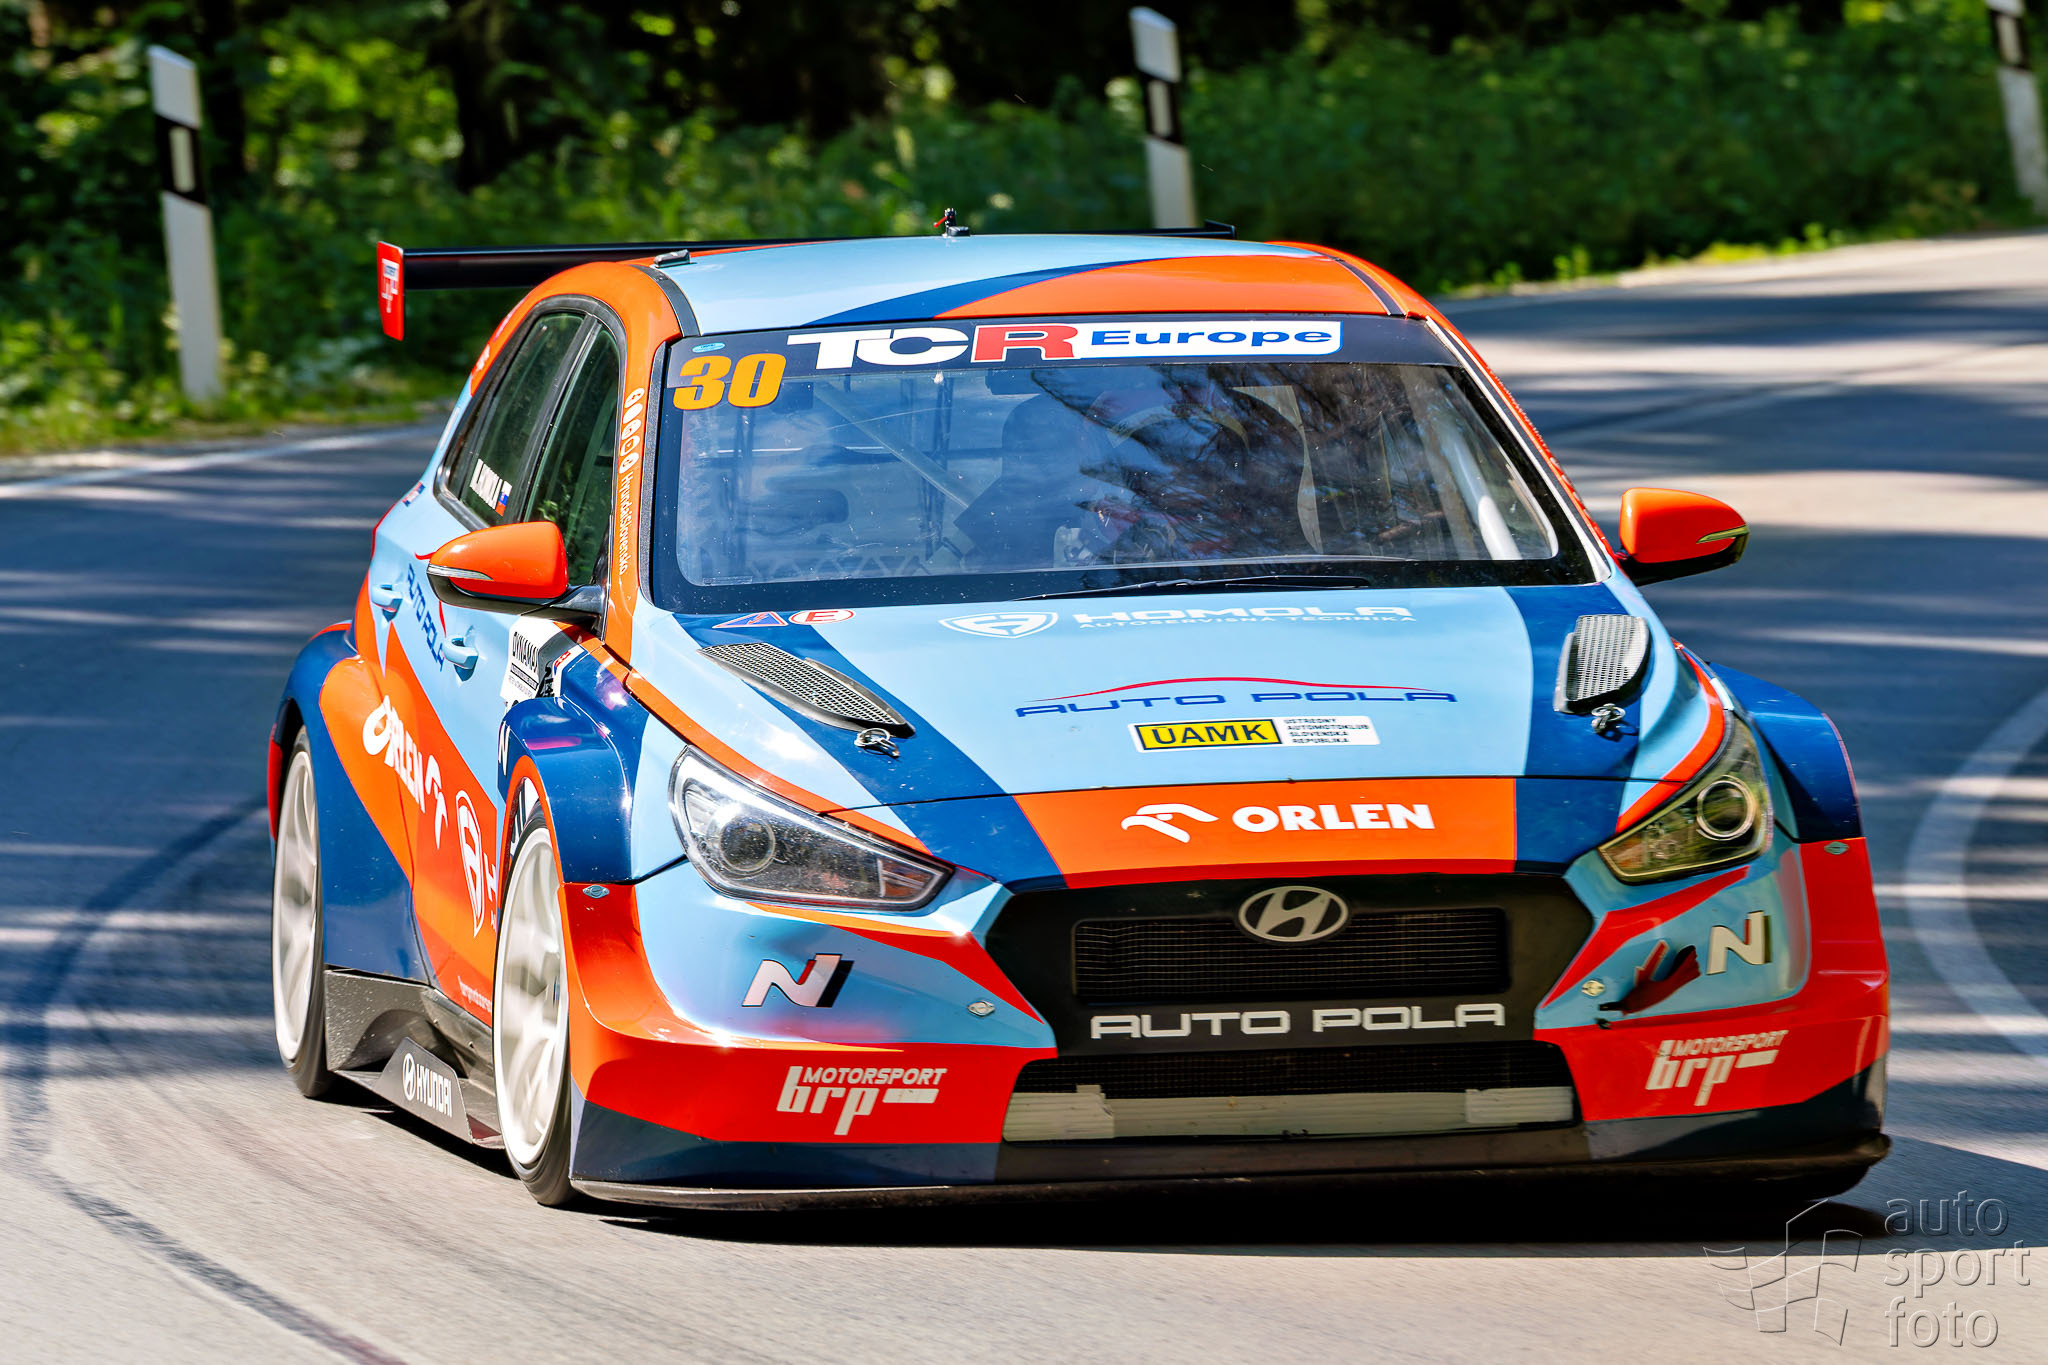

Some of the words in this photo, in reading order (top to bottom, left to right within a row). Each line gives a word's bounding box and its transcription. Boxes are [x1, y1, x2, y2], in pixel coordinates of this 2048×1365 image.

[786, 324, 1078, 369] TCR
[1091, 330, 1333, 347] Europe
[673, 353, 787, 411] 30
[805, 610, 839, 622] E
[1072, 607, 1412, 623] HOMOLA
[1015, 694, 1227, 717] AUTO
[1250, 691, 1458, 703] POLA
[362, 695, 426, 814] ORLEN
[1232, 803, 1436, 833] ORLEN
[1091, 1010, 1291, 1040] AUTO
[1312, 1003, 1505, 1033] POLA
[1671, 1030, 1790, 1057] MOTORSPORT
[416, 1063, 453, 1118] HYUNDAI
[803, 1067, 948, 1085] MOTORSPORT
[1645, 1040, 1737, 1106] brp
[777, 1066, 880, 1136] brp
